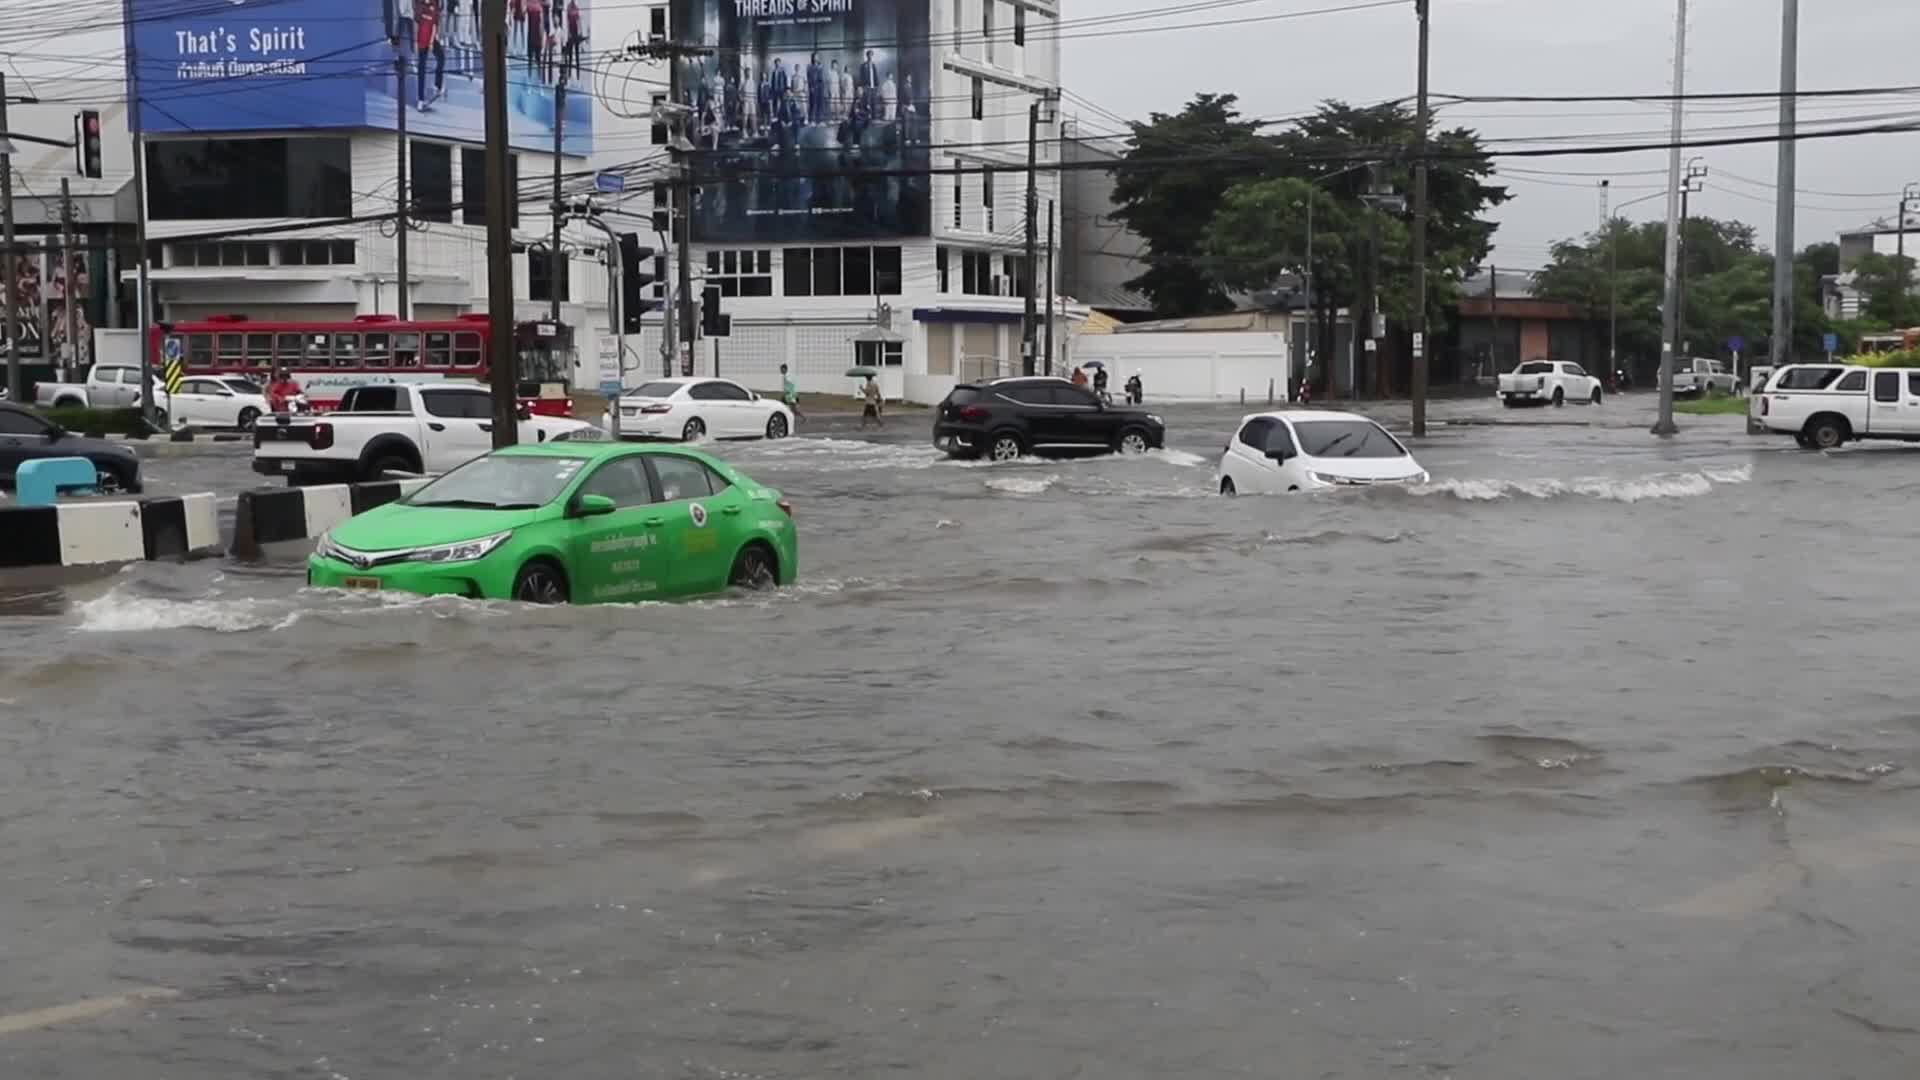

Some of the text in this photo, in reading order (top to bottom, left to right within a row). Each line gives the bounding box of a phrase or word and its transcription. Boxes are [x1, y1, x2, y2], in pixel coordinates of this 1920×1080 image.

[734, 0, 794, 17] THREADS
[811, 0, 853, 13] SPIRIT
[176, 25, 305, 55] That's Spirit
